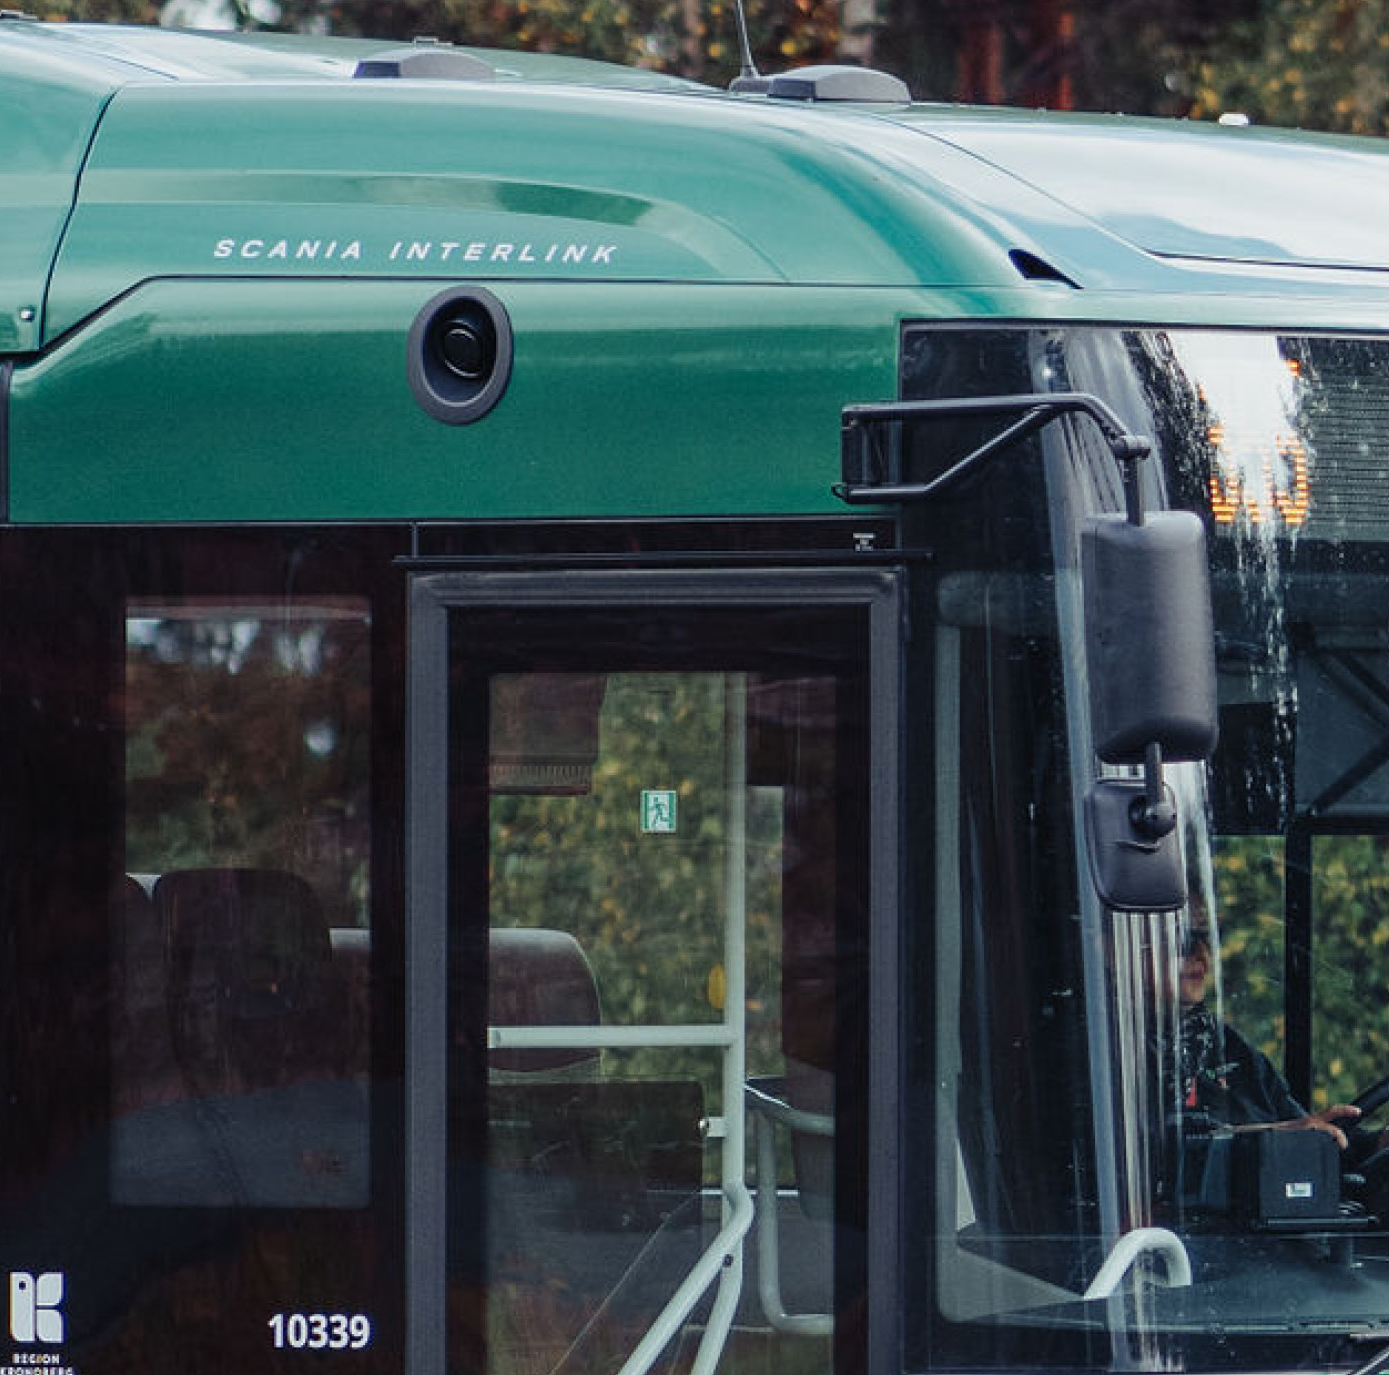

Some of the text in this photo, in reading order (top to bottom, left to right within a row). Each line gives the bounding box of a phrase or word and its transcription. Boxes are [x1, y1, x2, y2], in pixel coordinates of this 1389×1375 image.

[213, 239, 621, 265] SCANIA INTERLINK
[267, 1313, 371, 1350] 10339
